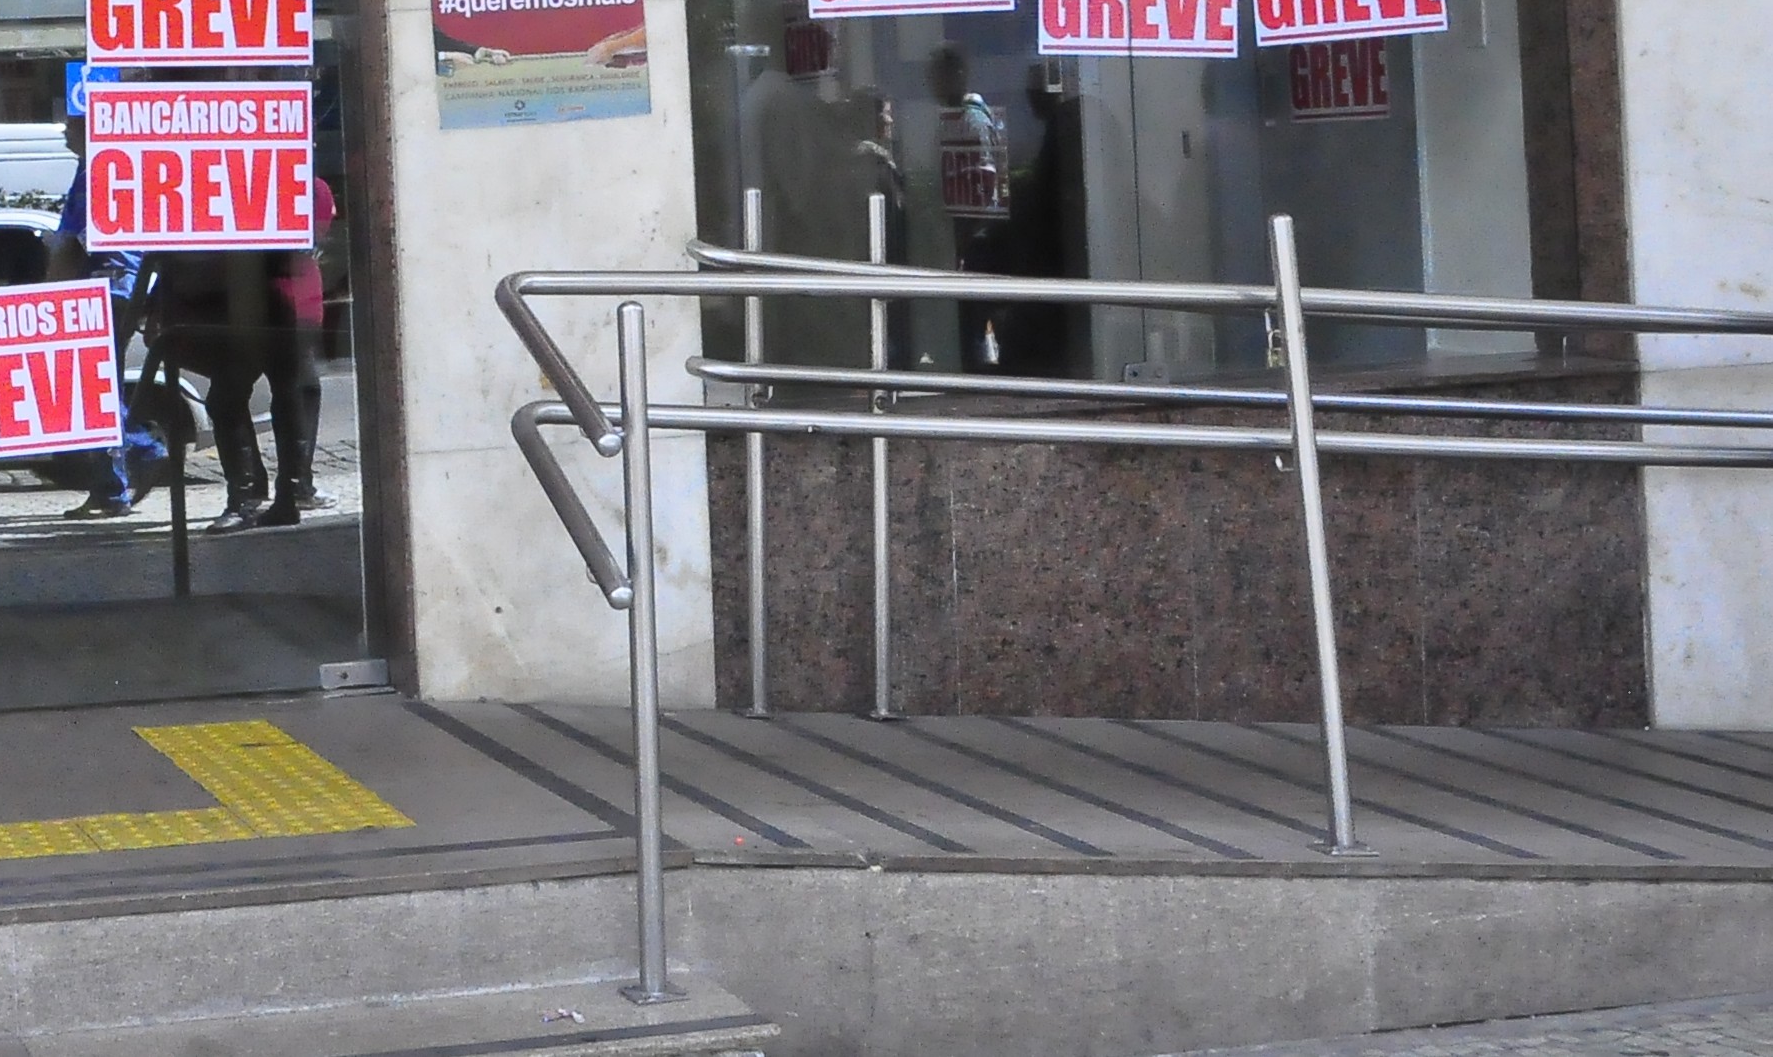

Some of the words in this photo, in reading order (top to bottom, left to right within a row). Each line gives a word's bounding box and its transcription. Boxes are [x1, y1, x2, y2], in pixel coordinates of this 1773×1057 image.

[1290, 36, 1388, 110] GREVE
[94, 96, 256, 134] BANCÁRIOS
[264, 100, 303, 133] EM
[90, 149, 309, 235] GREVE
[63, 297, 103, 333] EM
